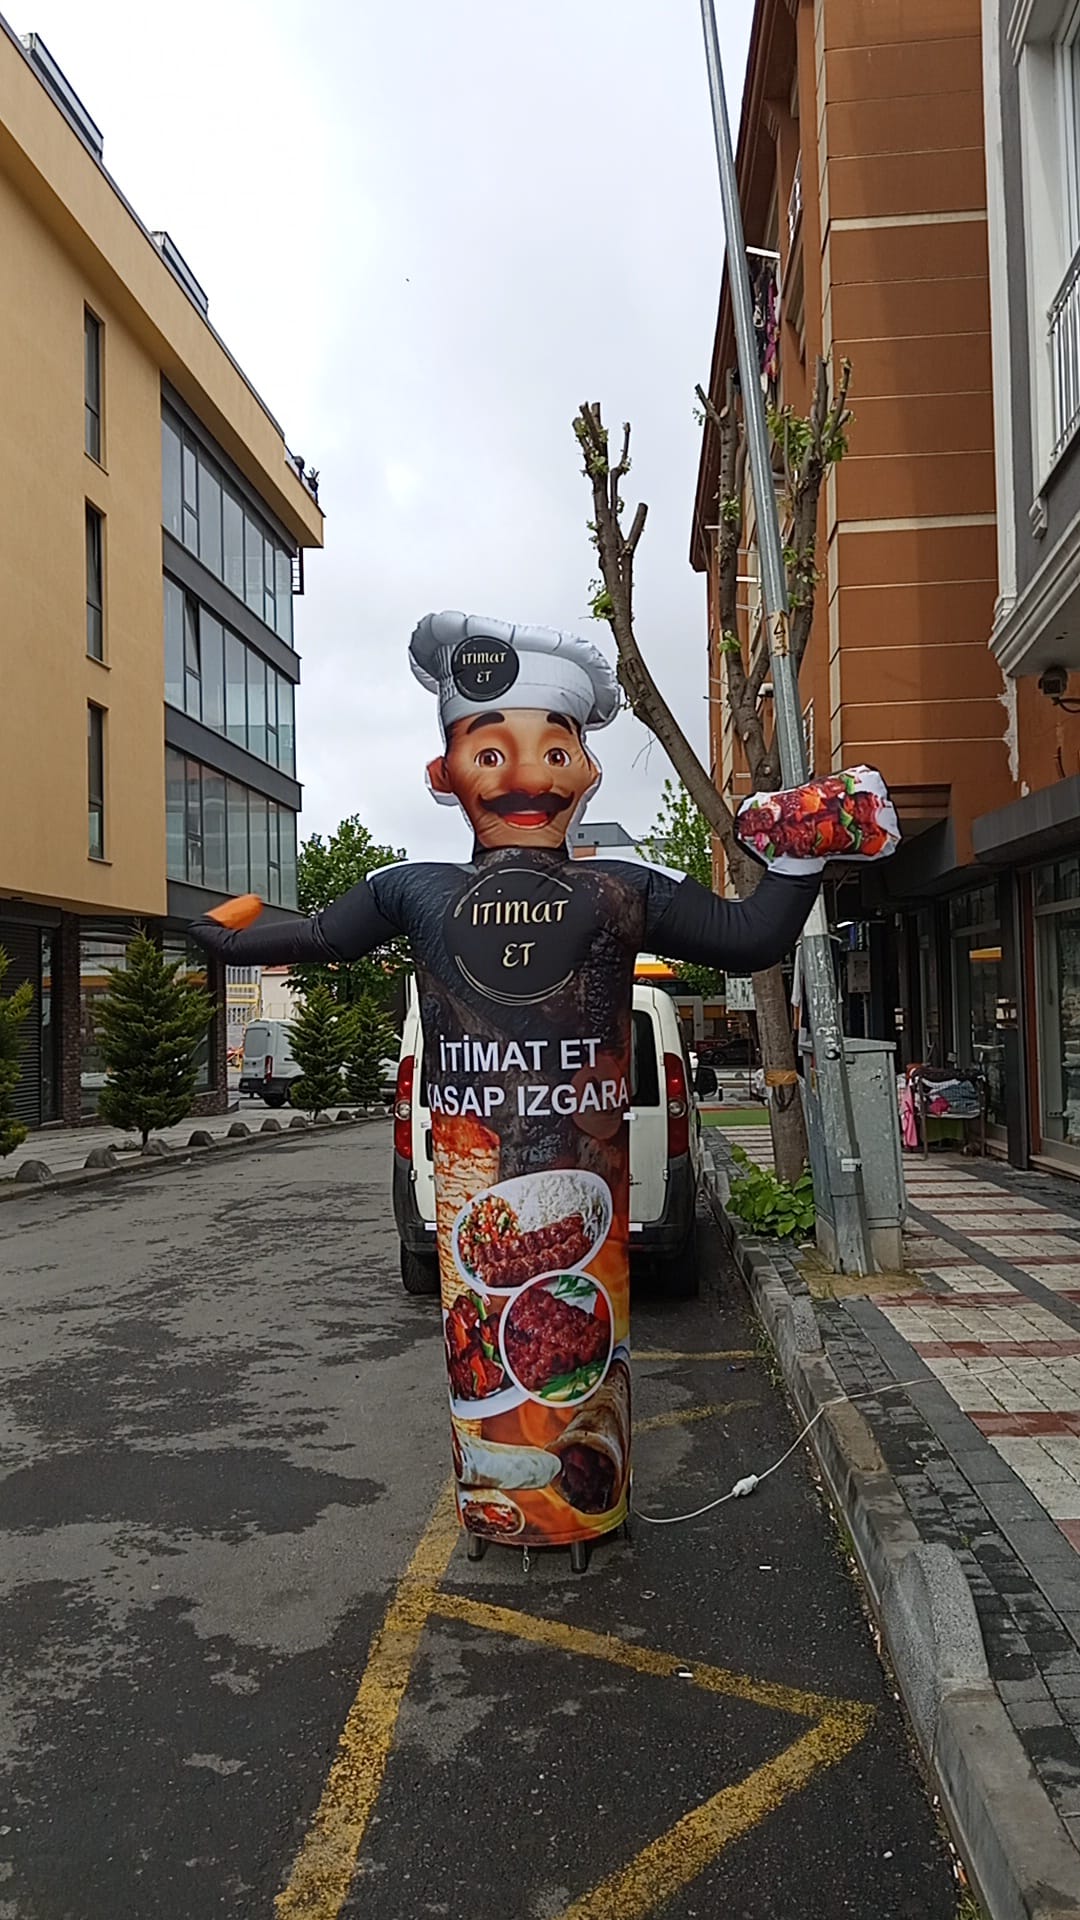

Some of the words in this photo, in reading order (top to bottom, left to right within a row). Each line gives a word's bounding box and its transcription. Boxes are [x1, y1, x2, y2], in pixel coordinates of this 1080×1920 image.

[439, 1034, 548, 1072] İTİMAT
[560, 1037, 602, 1071] ET
[517, 1077, 629, 1117] IZGARA
